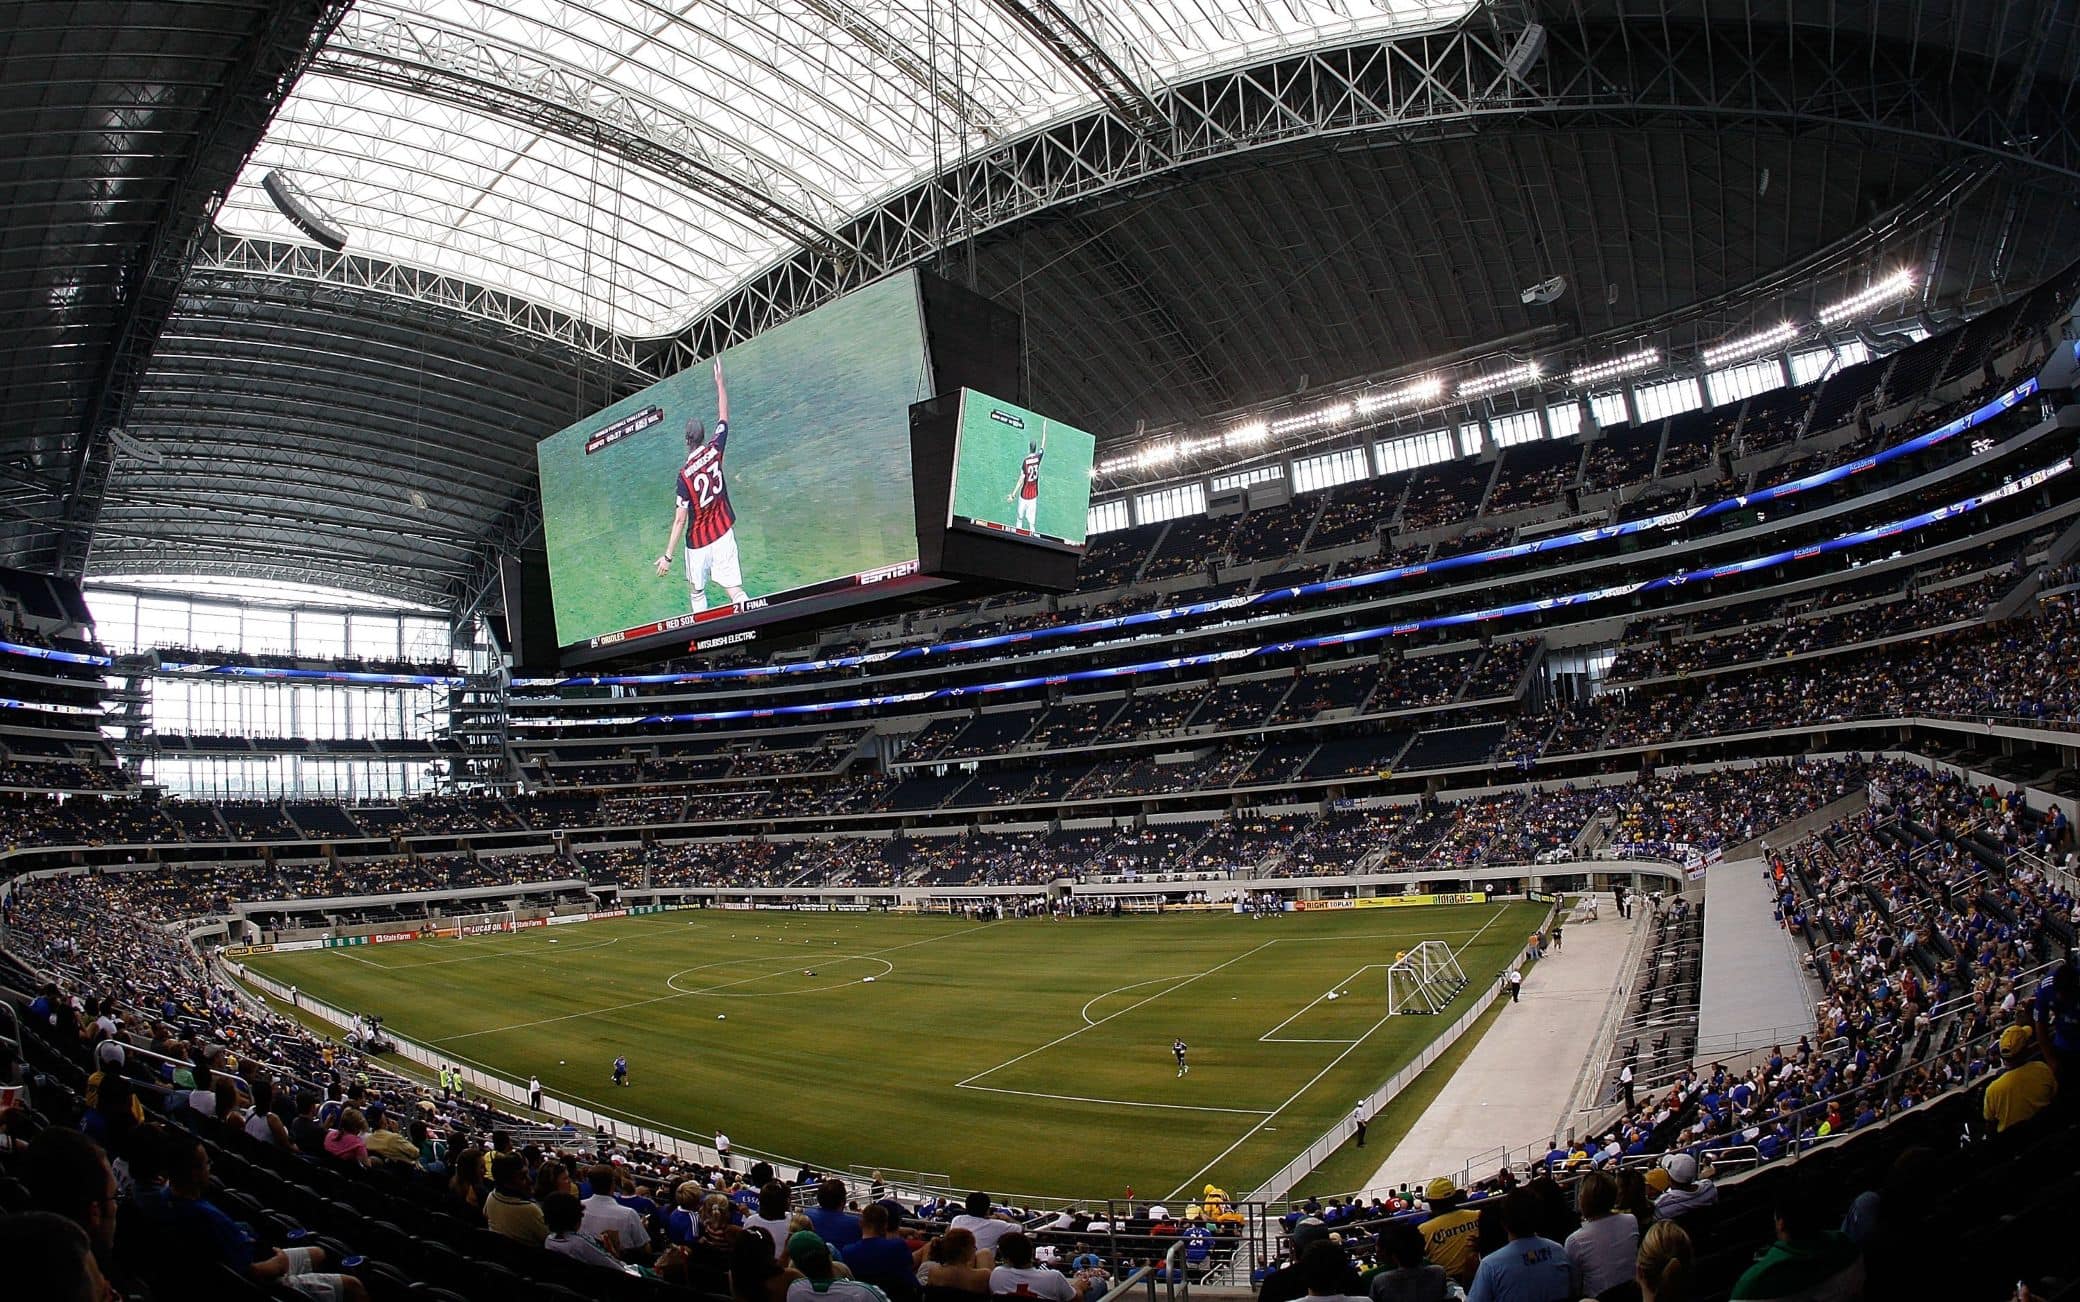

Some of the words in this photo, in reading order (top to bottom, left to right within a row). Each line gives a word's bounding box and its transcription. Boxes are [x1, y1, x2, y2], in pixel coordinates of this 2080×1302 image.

[1027, 465, 1039, 482] 23
[693, 461, 724, 508] 23
[1793, 544, 1822, 557] Academy
[601, 632, 625, 645] ORIOLES
[657, 622, 663, 632] 6
[666, 619, 680, 630] RED
[681, 615, 695, 627] SOX
[733, 605, 739, 614] 2
[747, 599, 768, 610] FINAL
[1393, 622, 1420, 633] Academy
[728, 631, 757, 643] ELECTRIC
[1306, 901, 1329, 910] RIGHT
[471, 924, 492, 934] LUCAS
[492, 923, 502, 931] OIL
[516, 921, 529, 929] State
[529, 920, 542, 928] Farm
[383, 934, 397, 942] State
[397, 933, 411, 941] Farm
